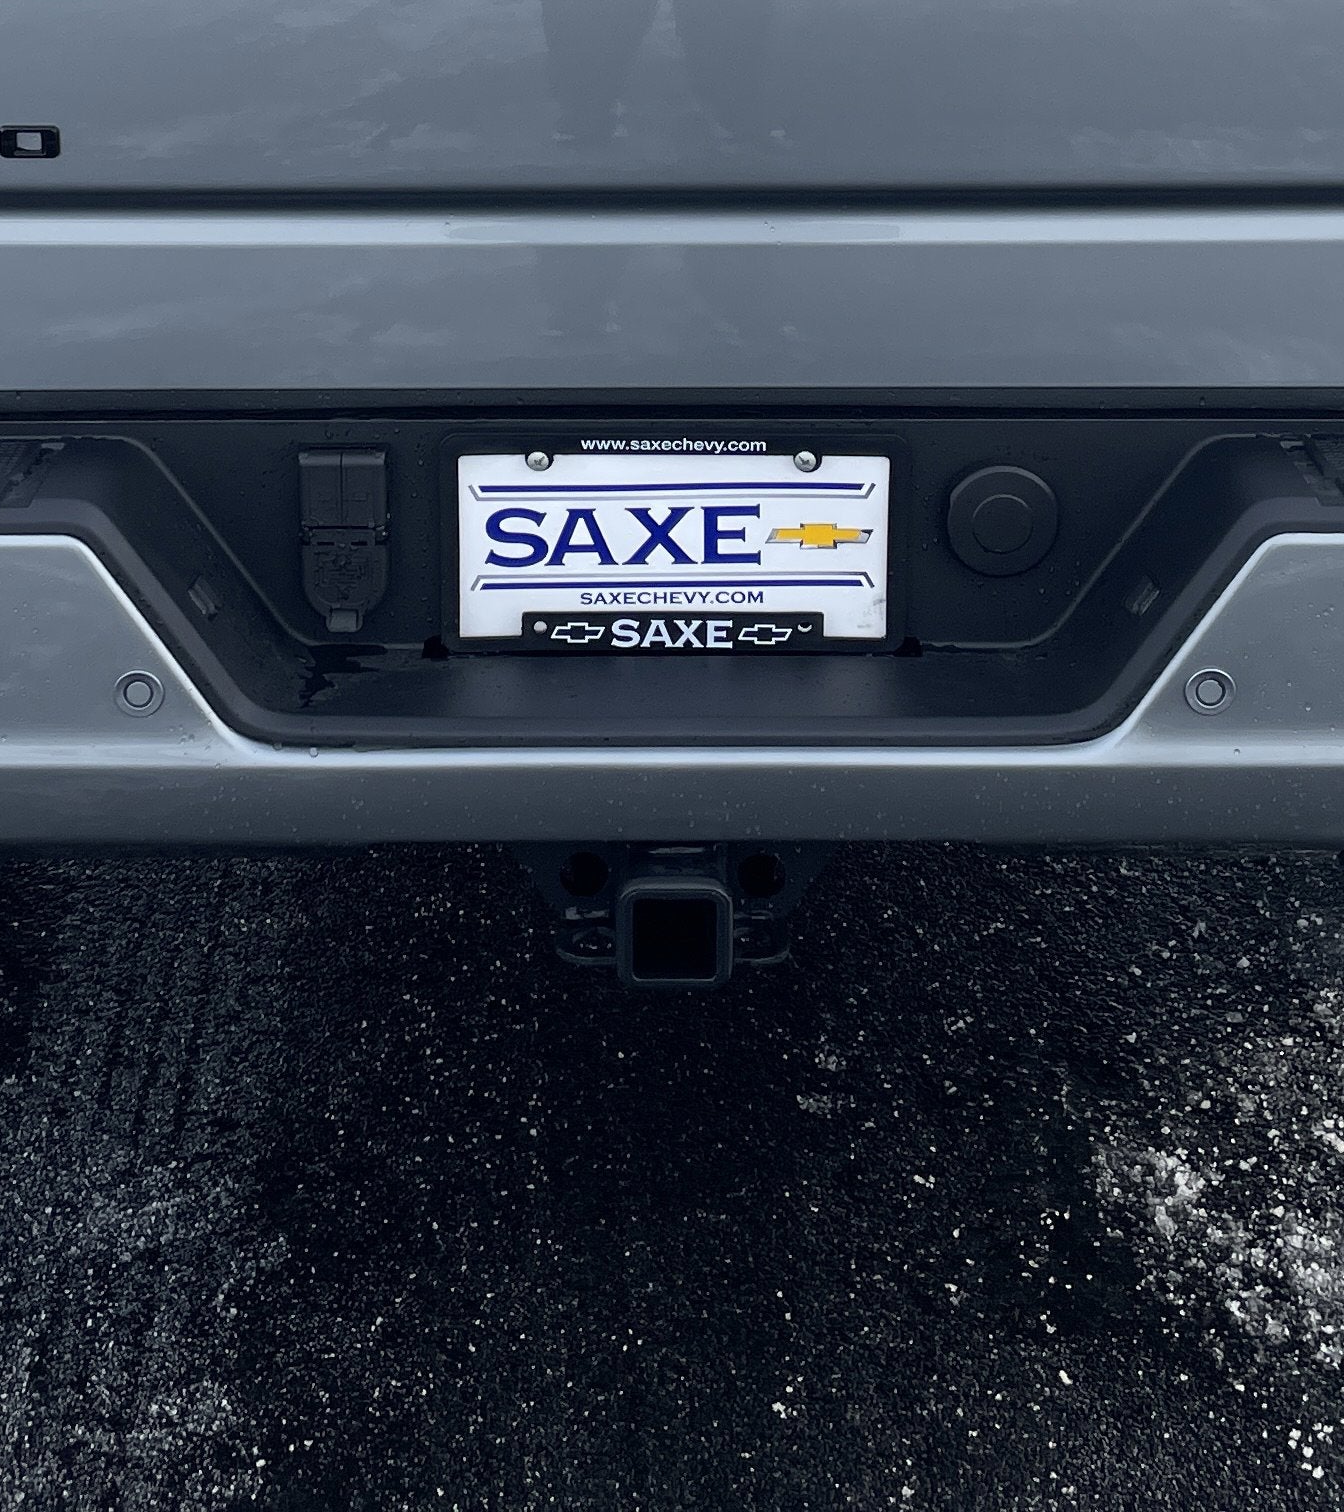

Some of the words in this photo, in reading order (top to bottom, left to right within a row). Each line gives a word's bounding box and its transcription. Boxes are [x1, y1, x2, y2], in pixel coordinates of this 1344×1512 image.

[580, 437, 767, 454] www.saxechevy.com
[484, 503, 762, 568] SAXE
[580, 590, 764, 605] SAXECHEVY.COM
[611, 619, 734, 649] SAXE
